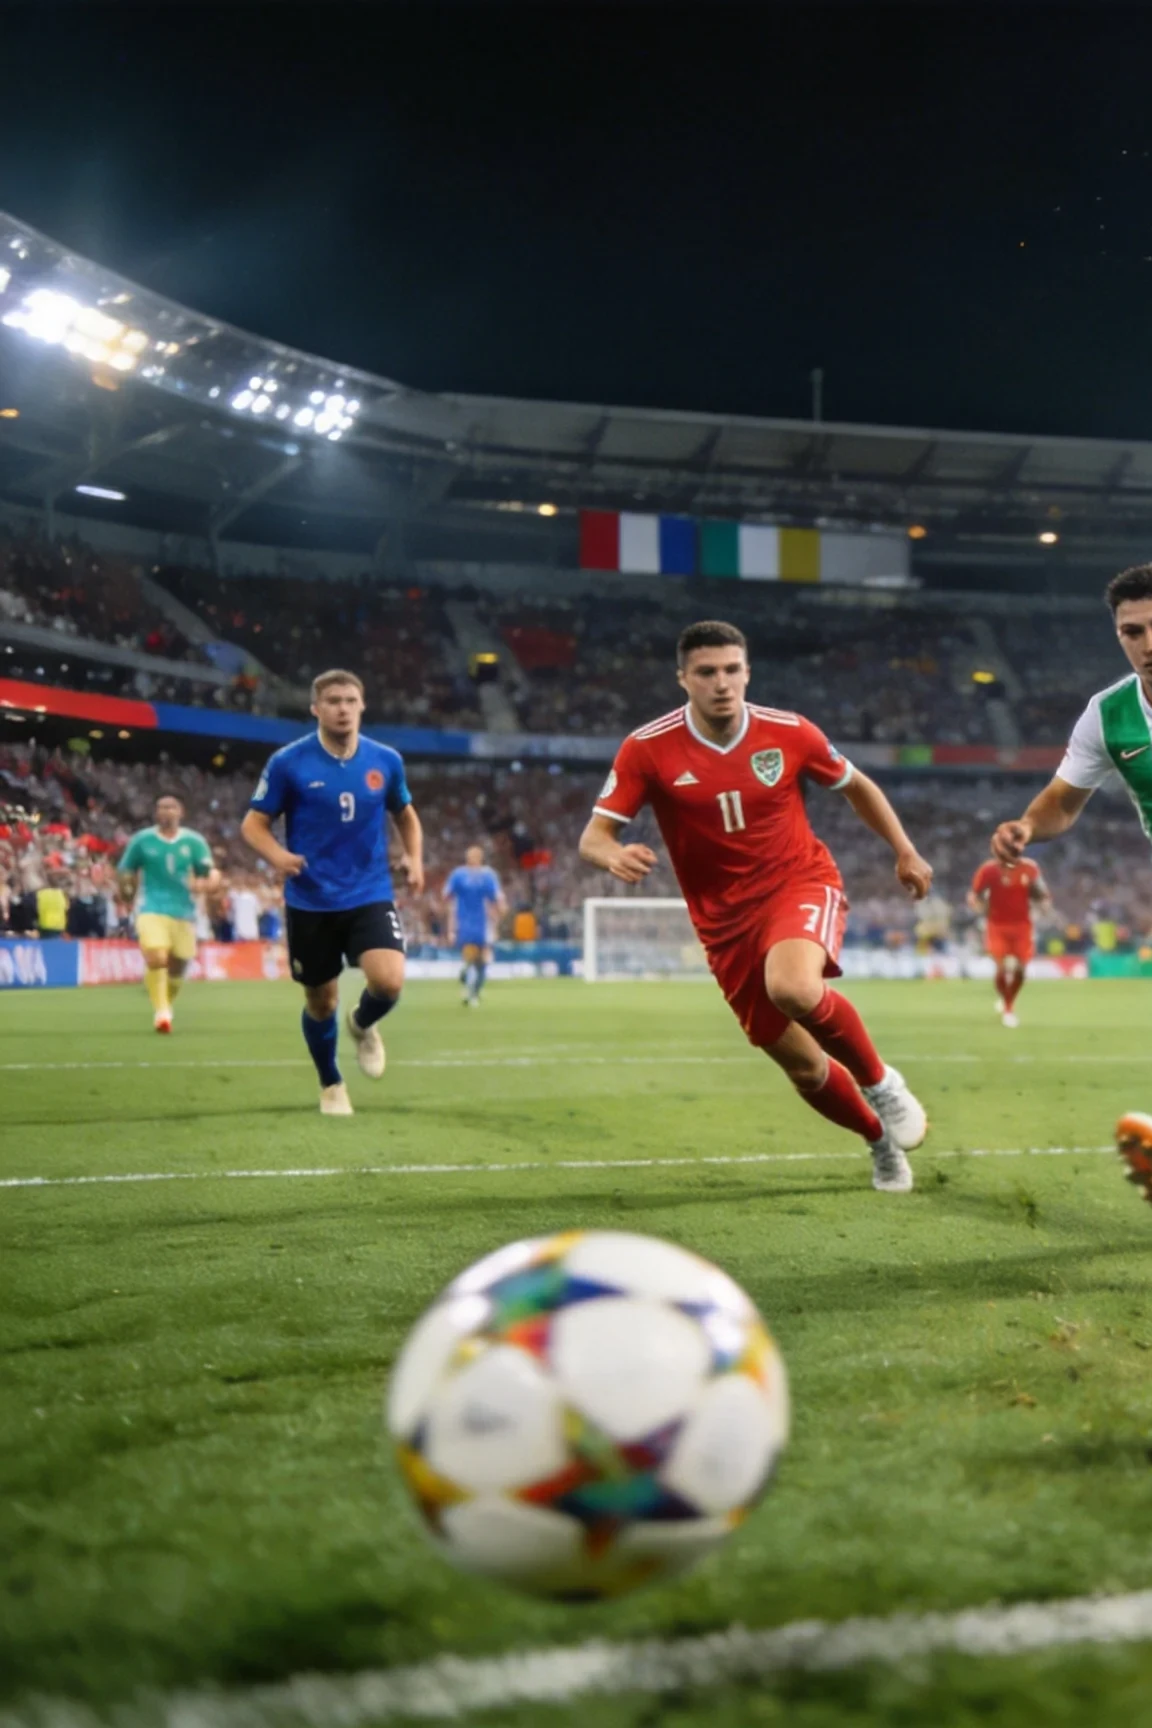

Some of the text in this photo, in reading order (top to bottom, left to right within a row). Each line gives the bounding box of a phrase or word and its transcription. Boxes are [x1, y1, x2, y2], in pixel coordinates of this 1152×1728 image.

[339, 791, 355, 822] 9
[716, 790, 746, 833] 11
[798, 903, 821, 934] 7
